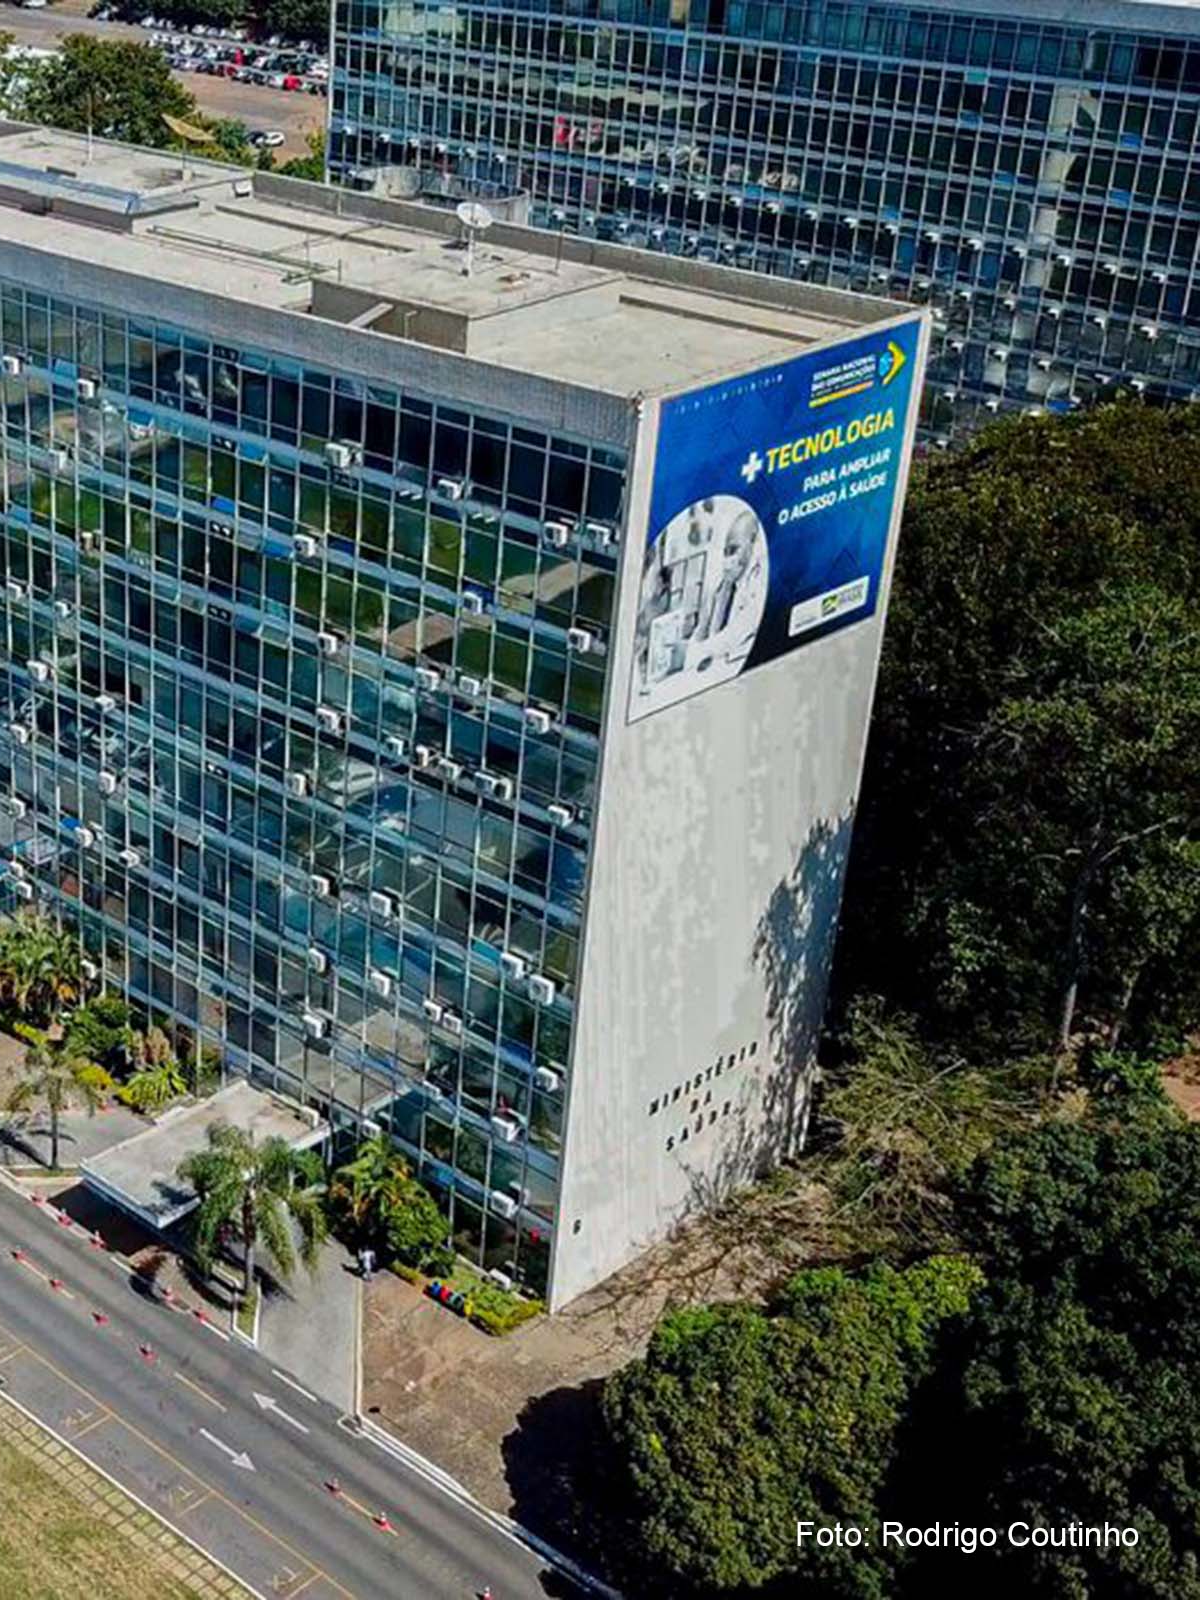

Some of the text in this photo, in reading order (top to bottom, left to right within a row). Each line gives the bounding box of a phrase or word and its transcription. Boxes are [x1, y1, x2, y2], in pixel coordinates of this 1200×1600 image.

[766, 407, 895, 474] TECNOLOGIA
[802, 448, 892, 493] PARA AMPLIAR
[777, 471, 888, 525] O ACESSO À SAÚDE
[689, 1089, 711, 1114] DA
